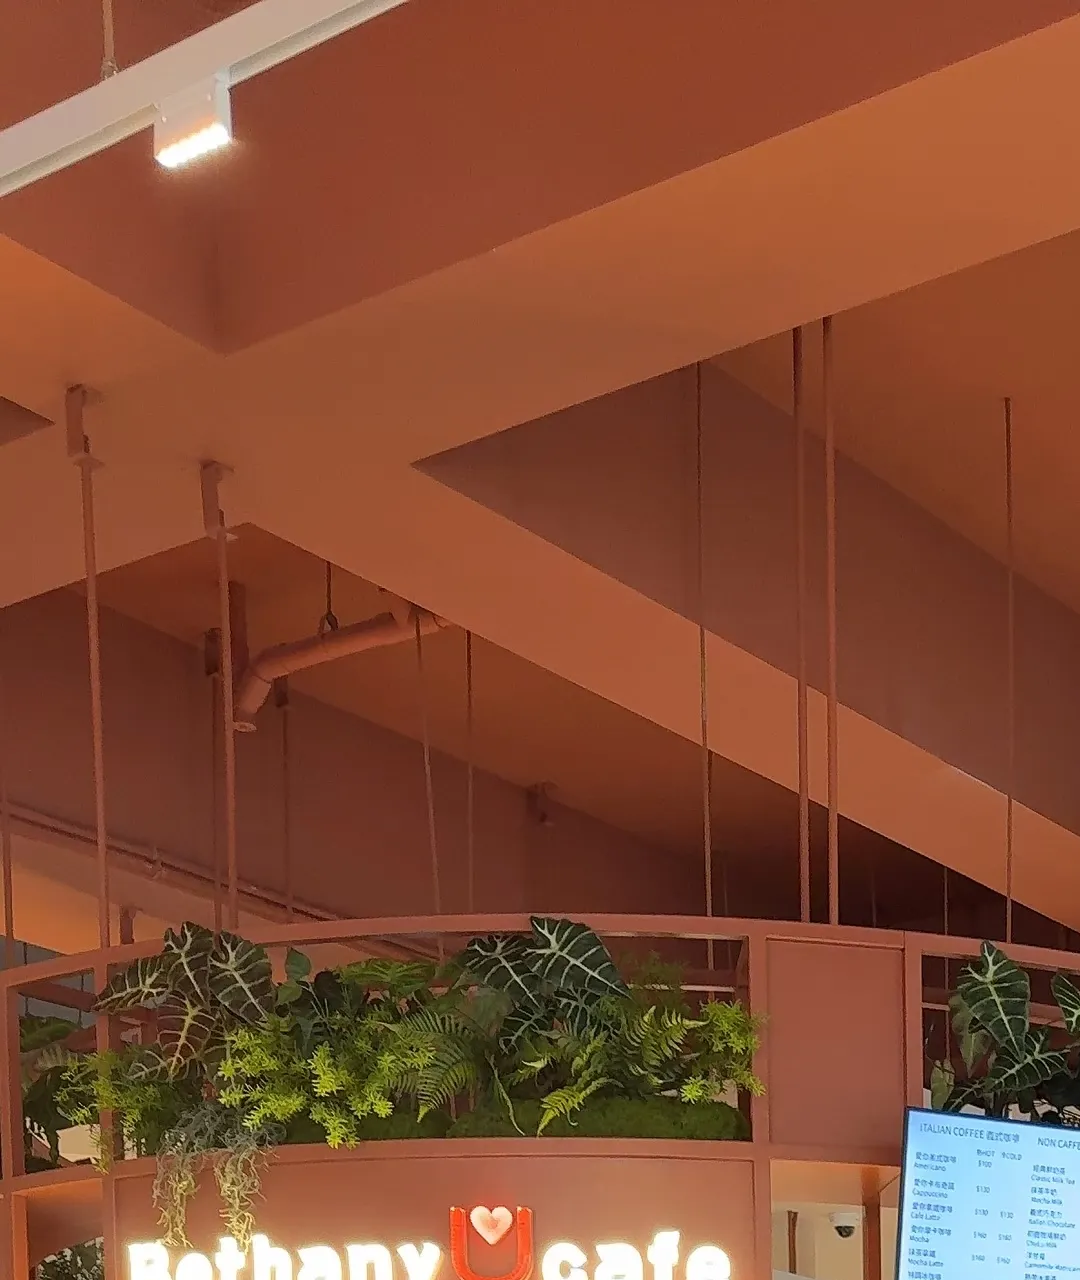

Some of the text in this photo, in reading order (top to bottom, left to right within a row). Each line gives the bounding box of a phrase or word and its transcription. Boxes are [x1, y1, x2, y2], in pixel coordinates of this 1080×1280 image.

[920, 1123, 951, 1135] ITALIAN
[953, 1126, 984, 1139] COFFEE
[1038, 1137, 1056, 1148] NON
